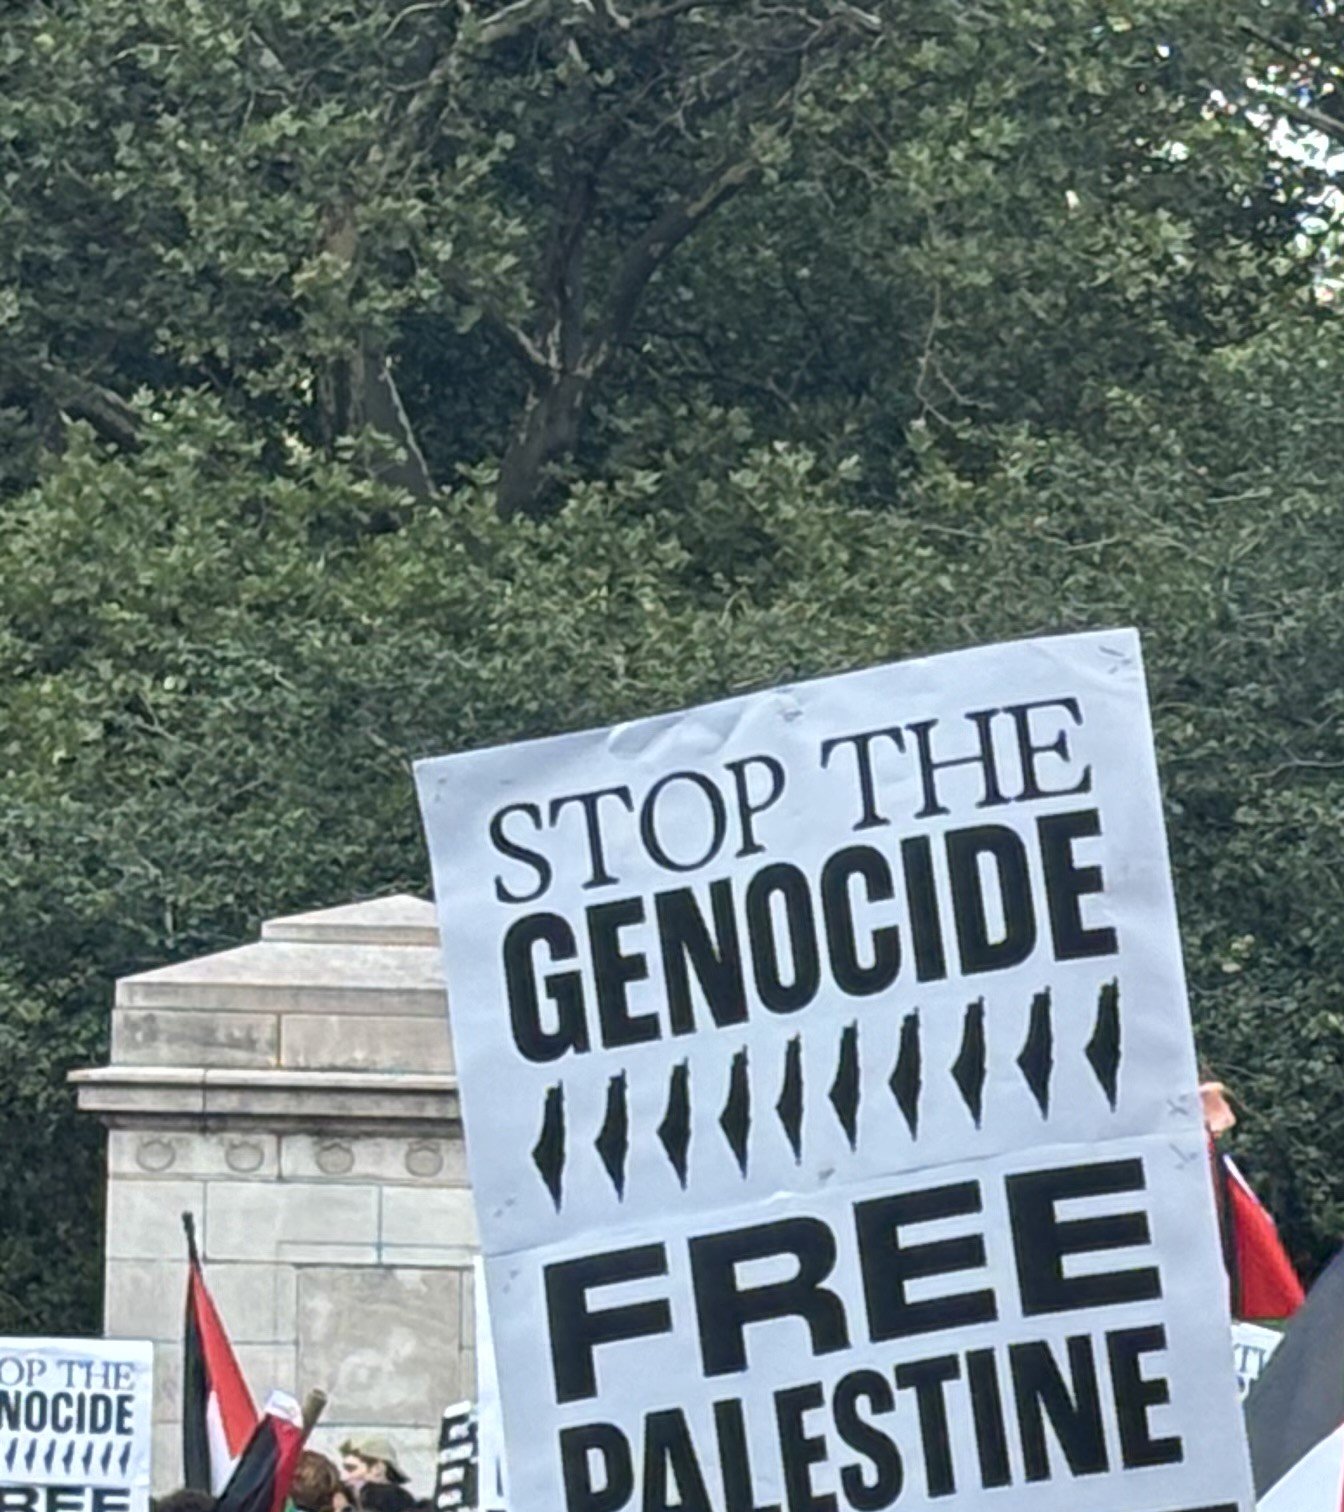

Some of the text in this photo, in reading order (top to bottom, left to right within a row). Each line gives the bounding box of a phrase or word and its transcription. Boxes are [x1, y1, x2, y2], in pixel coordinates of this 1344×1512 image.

[488, 698, 1092, 903] STOP THE
[503, 808, 1119, 1063] GENOCIDE
[0, 1357, 135, 1389] OP THE
[543, 1158, 1163, 1404] FREE
[0, 1390, 135, 1435] NOCIDE
